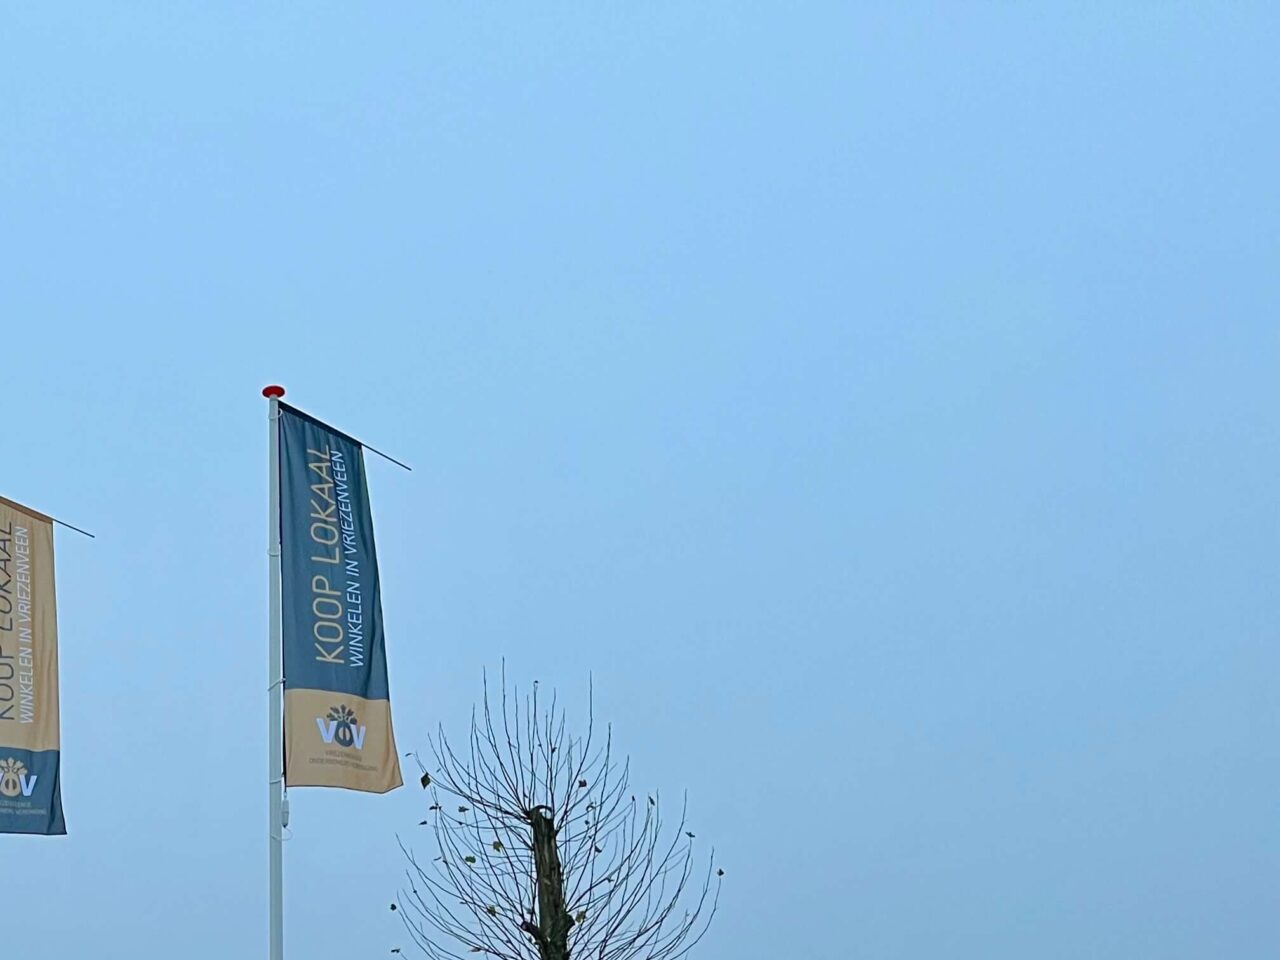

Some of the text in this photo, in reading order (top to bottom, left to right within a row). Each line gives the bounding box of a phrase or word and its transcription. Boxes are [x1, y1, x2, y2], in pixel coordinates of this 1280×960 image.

[17, 526, 34, 724] WINKELEN IN VRIEZENVEEN
[307, 444, 345, 665] KOOP LOKAAL
[331, 450, 364, 668] WINKELEN IN VRIEZENVEEN
